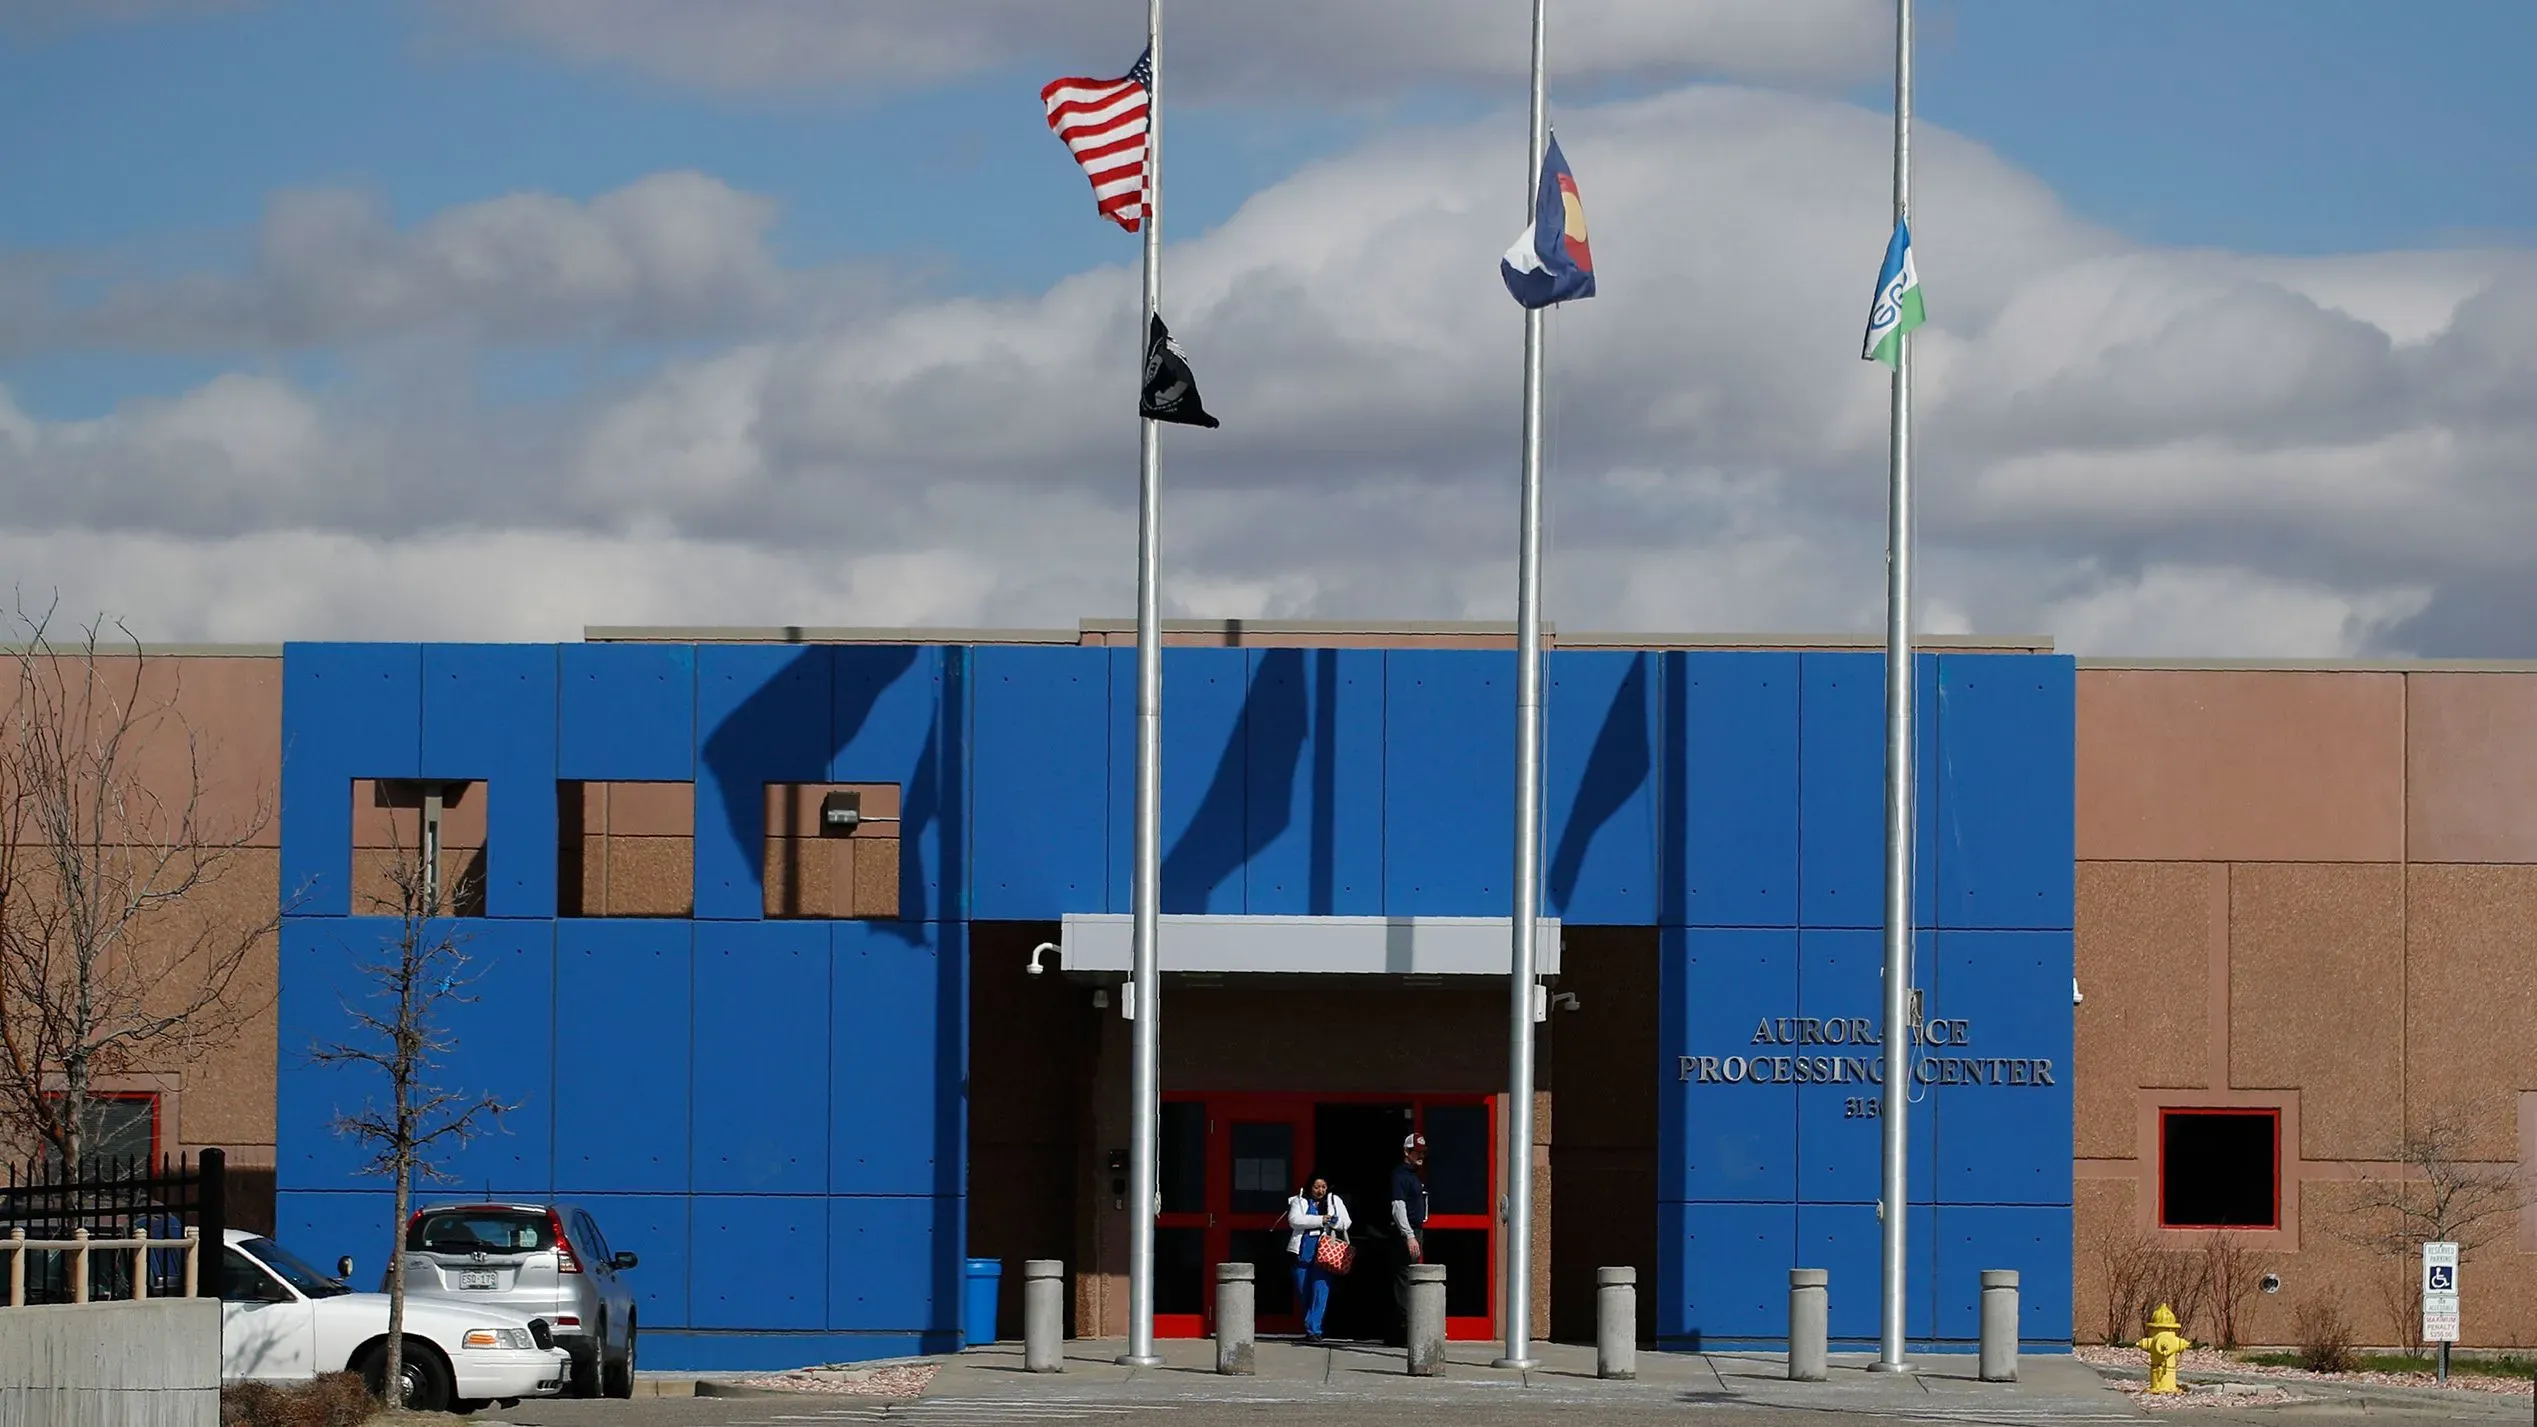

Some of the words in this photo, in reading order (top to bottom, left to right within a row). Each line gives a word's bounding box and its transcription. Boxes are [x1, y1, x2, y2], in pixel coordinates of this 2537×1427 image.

[1750, 1016, 1884, 1045] AUROR
[1915, 1056, 2055, 1086] CENTER
[1843, 1096, 1884, 1119] 313
